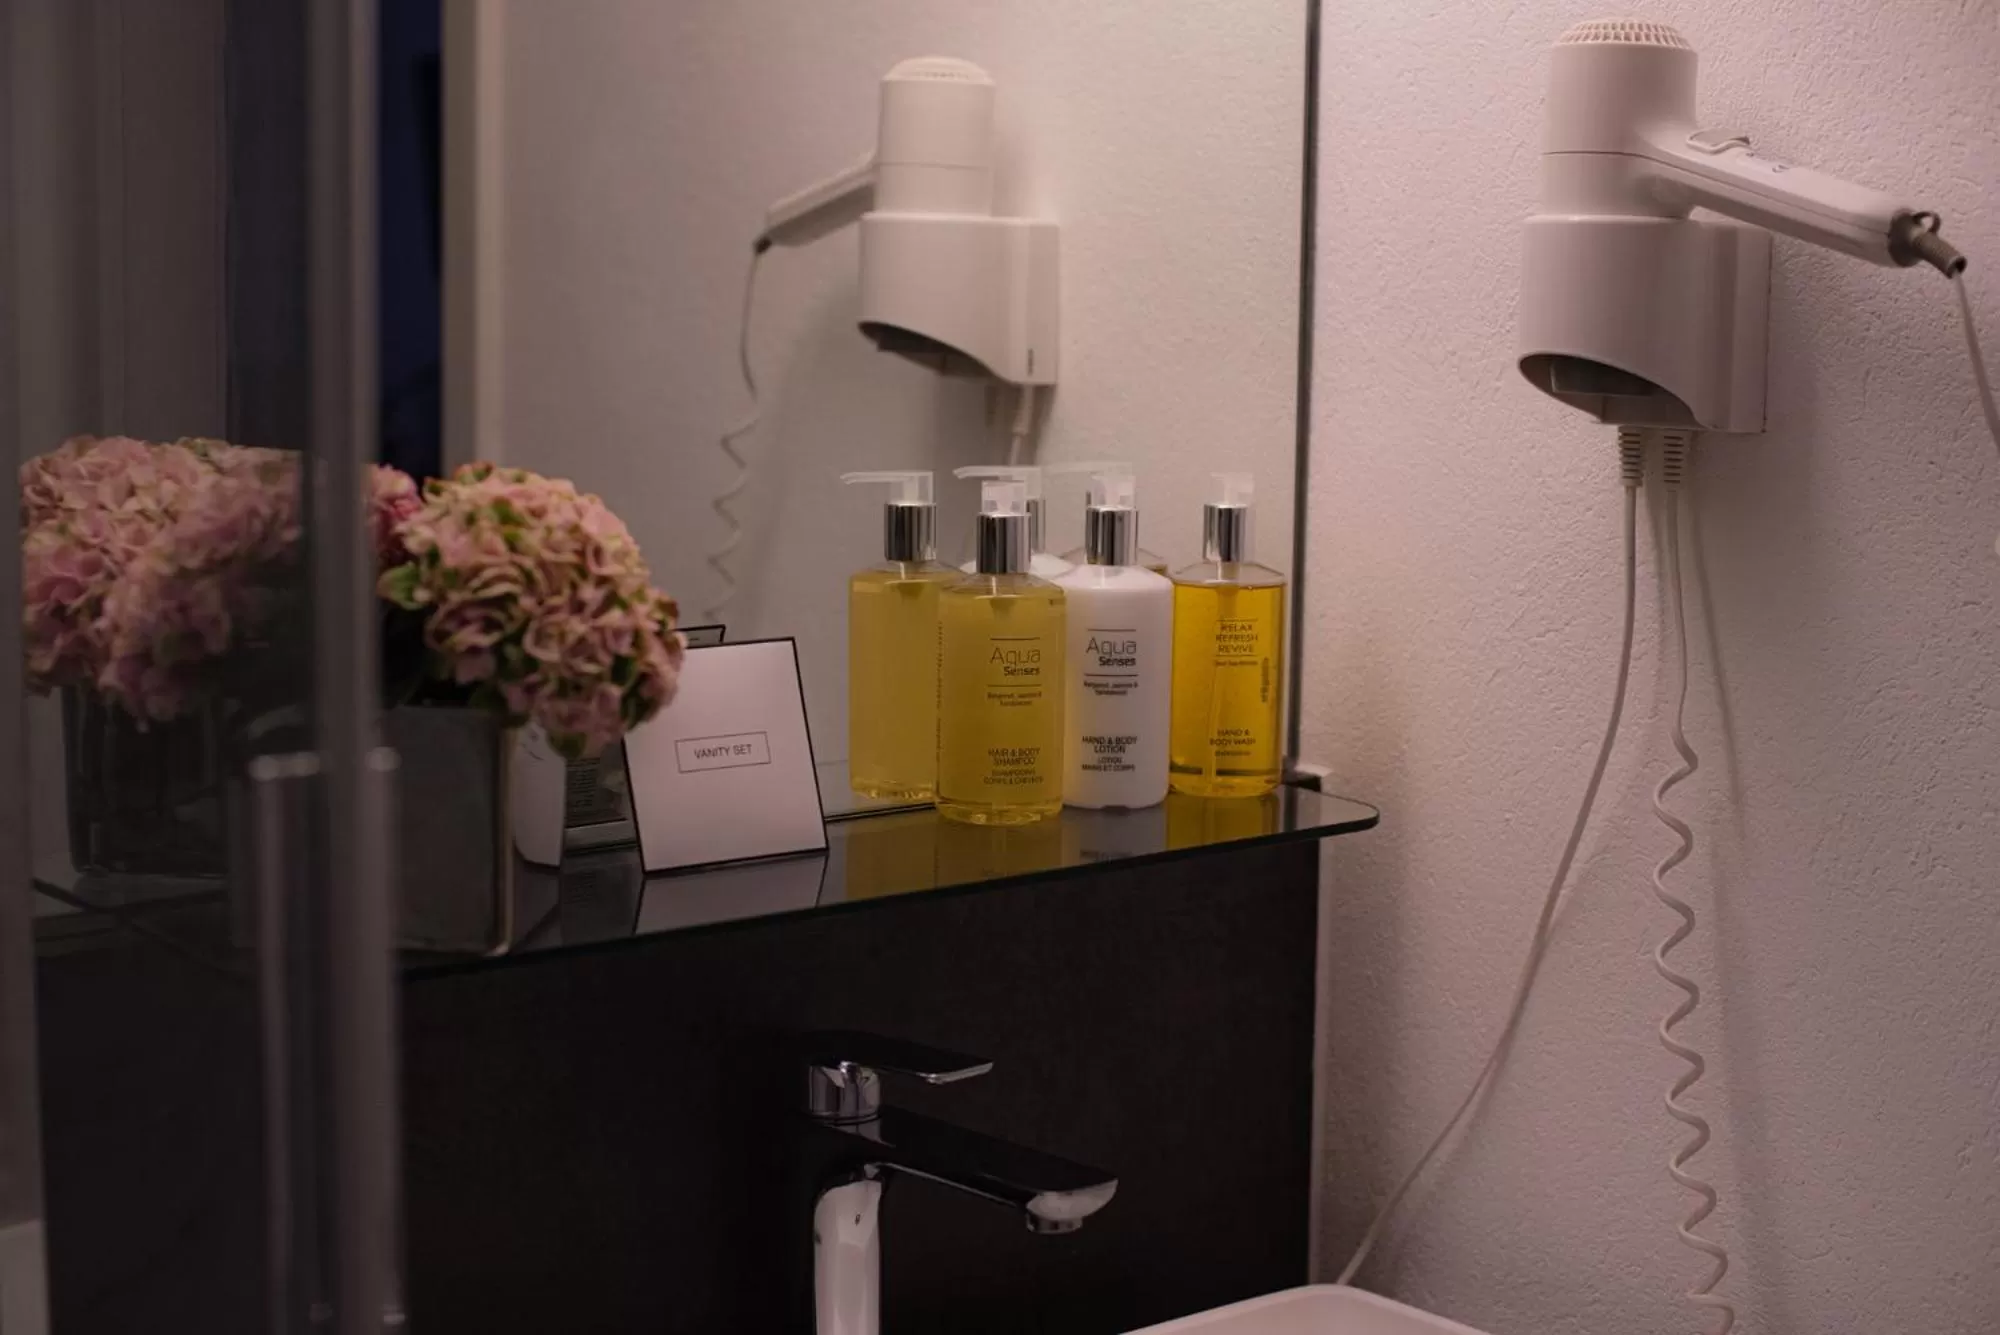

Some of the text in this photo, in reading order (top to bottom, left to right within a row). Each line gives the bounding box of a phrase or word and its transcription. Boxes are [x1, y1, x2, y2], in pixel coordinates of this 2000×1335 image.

[1220, 623, 1253, 632] RELAX
[1215, 633, 1258, 642] REFRESH
[1085, 636, 1137, 658] Aqua
[1218, 643, 1253, 653] REVIVE
[989, 646, 1041, 673] Aqua
[1098, 655, 1137, 667] Senses
[1003, 665, 1041, 677] Senses
[1217, 728, 1242, 737] HAND
[1082, 735, 1138, 745] HAND & BODY
[1209, 737, 1256, 746] BODY WASH
[693, 743, 752, 760] VANITY SET
[987, 747, 1009, 757] HAIR
[1018, 747, 1041, 757] BODY
[1093, 744, 1126, 754] LOTION
